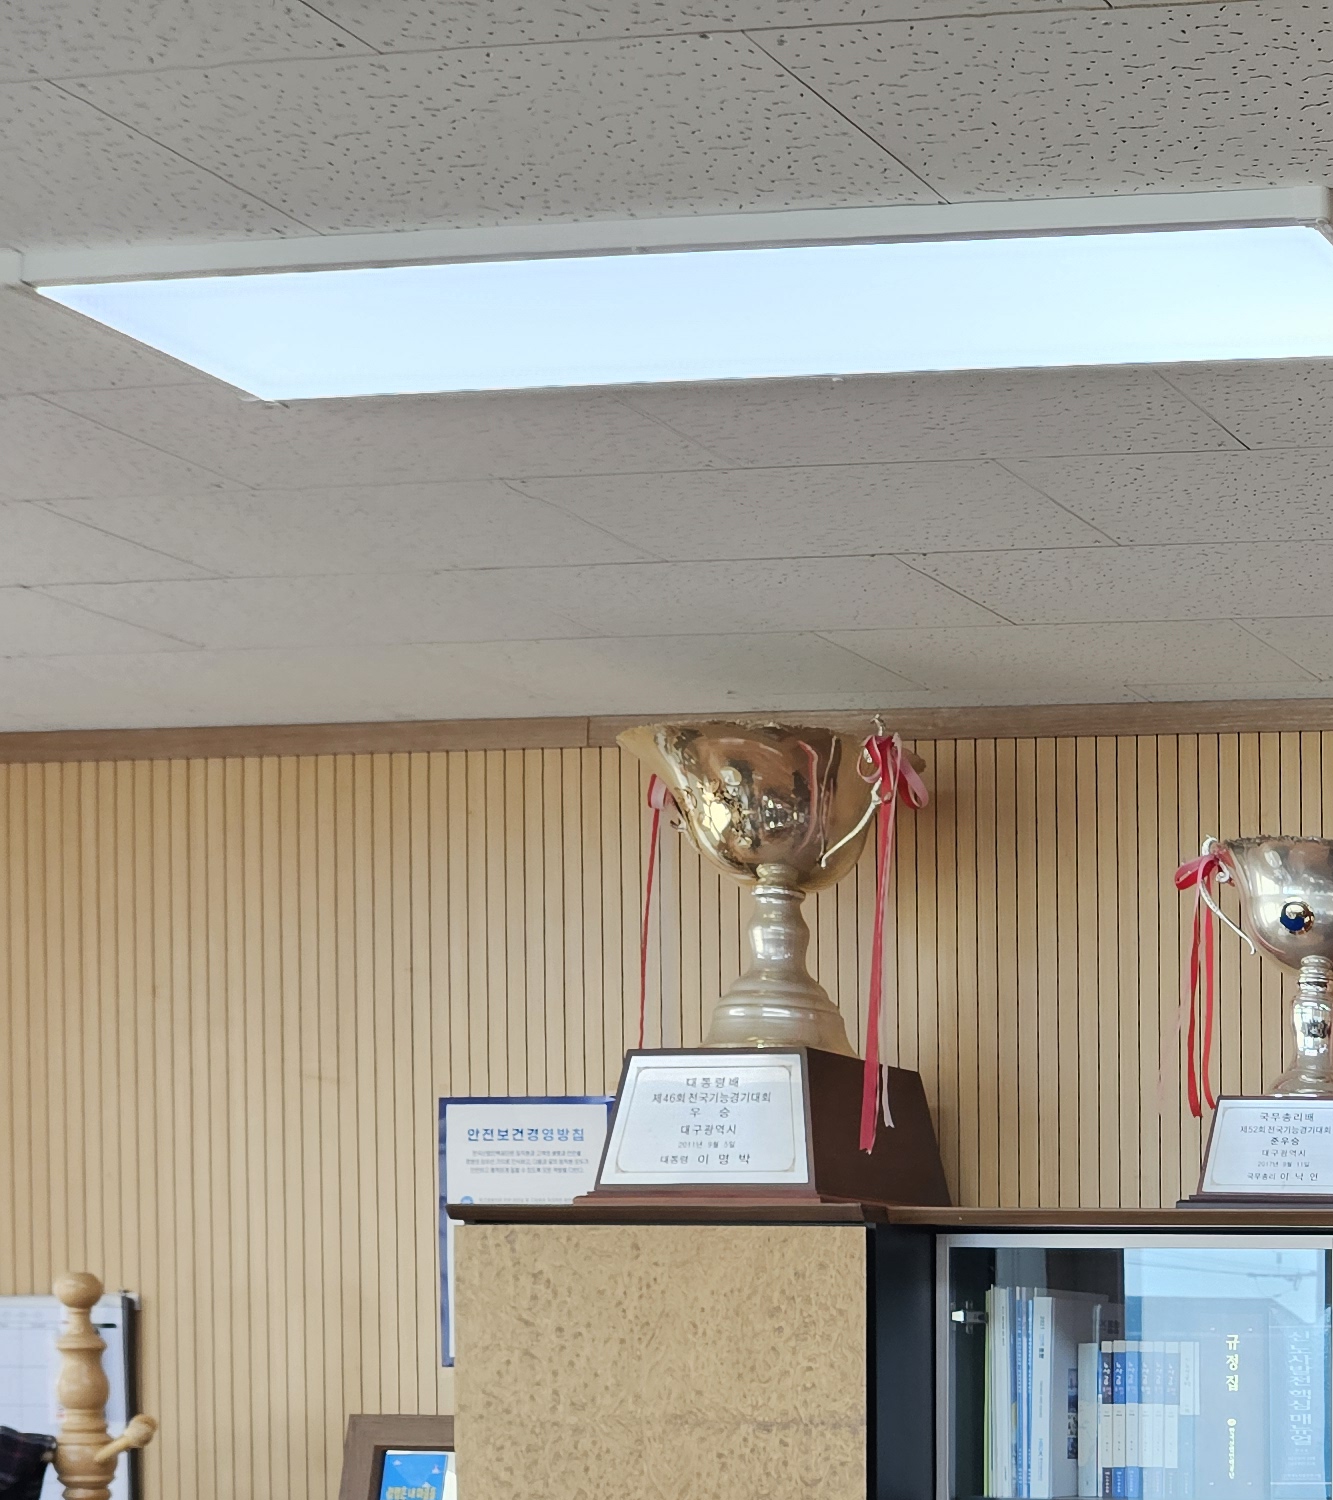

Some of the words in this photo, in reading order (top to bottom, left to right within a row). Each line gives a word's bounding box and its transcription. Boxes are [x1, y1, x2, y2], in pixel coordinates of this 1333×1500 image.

[686, 1076, 740, 1088] 대통령배
[652, 1092, 686, 1104] 제46회
[688, 1091, 772, 1104] 전국기능경기대회
[1260, 1112, 1314, 1122] 국무총리배
[680, 1124, 737, 1135] 대구광역시
[1240, 1125, 1266, 1134] 제52회
[467, 1128, 585, 1142] 안전보건경영방침
[1270, 1136, 1300, 1146] 준우승
[1261, 1149, 1306, 1158] 대구광역시
[660, 1155, 689, 1165] 대통령
[1247, 1172, 1276, 1181] 국무총리
[1225, 1334, 1241, 1392] 규정집
